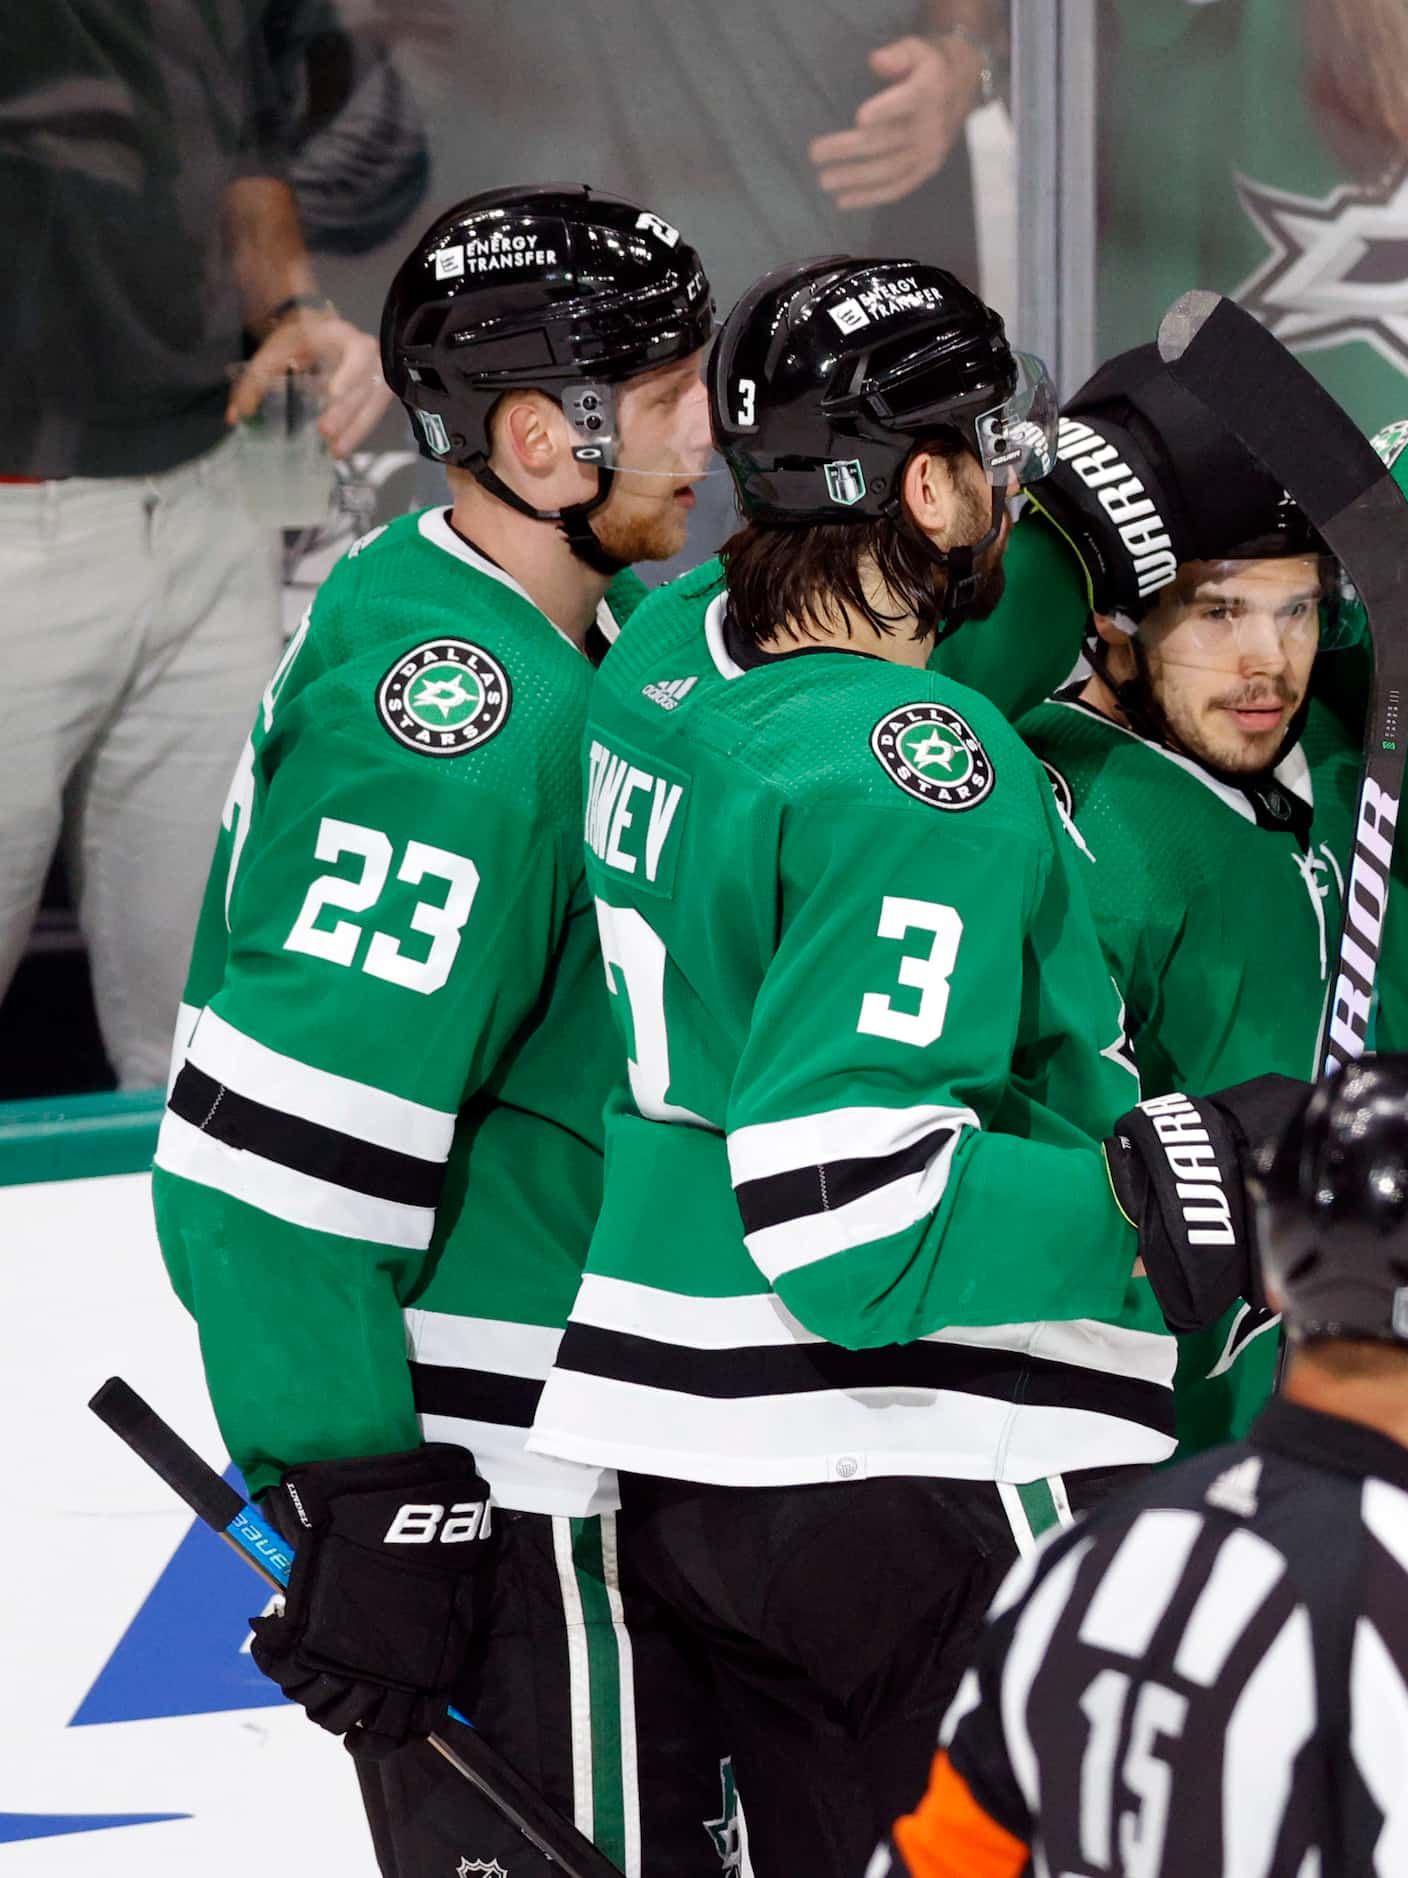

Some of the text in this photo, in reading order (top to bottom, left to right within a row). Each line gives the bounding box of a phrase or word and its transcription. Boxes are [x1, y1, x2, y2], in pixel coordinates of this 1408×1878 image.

[467, 235, 538, 258] ENERGY
[468, 250, 557, 274] TRANSFER
[858, 277, 918, 307] ENERGY
[868, 288, 943, 320] TRANSFER
[737, 378, 757, 426] 3
[399, 648, 501, 705] DALLAS
[388, 698, 479, 746] STARS
[881, 709, 978, 752] DALLAS
[897, 765, 985, 801] STARS
[283, 816, 480, 995] 23
[856, 895, 964, 1048] 3
[1078, 1668, 1190, 1878] 15
